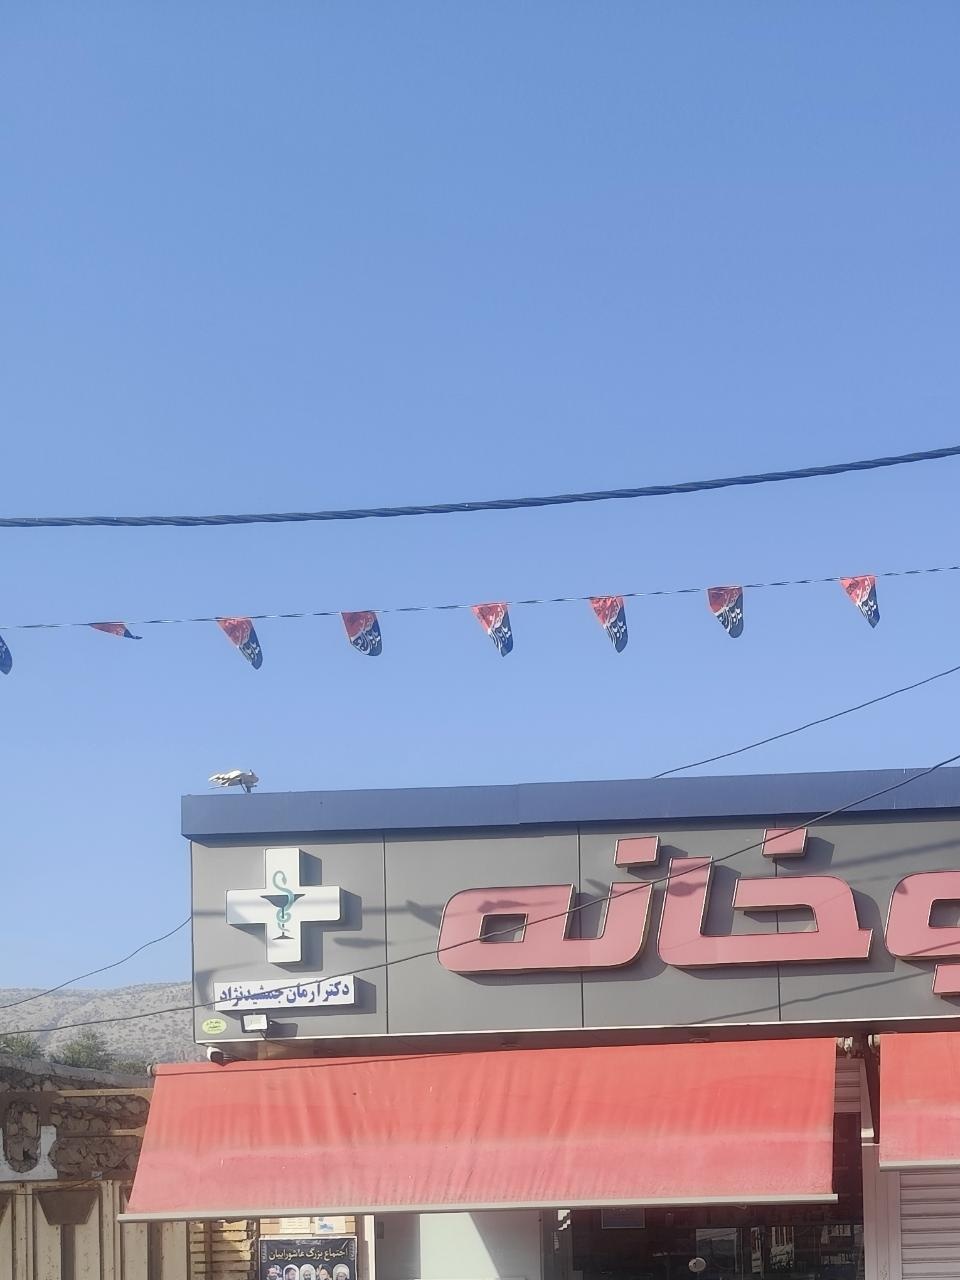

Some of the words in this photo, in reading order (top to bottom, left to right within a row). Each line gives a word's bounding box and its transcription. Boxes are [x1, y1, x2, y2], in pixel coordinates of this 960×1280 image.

[322, 980, 350, 1003] دکتر
[305, 1246, 323, 1261] بزرگ
[324, 1248, 348, 1261] اجتماع
